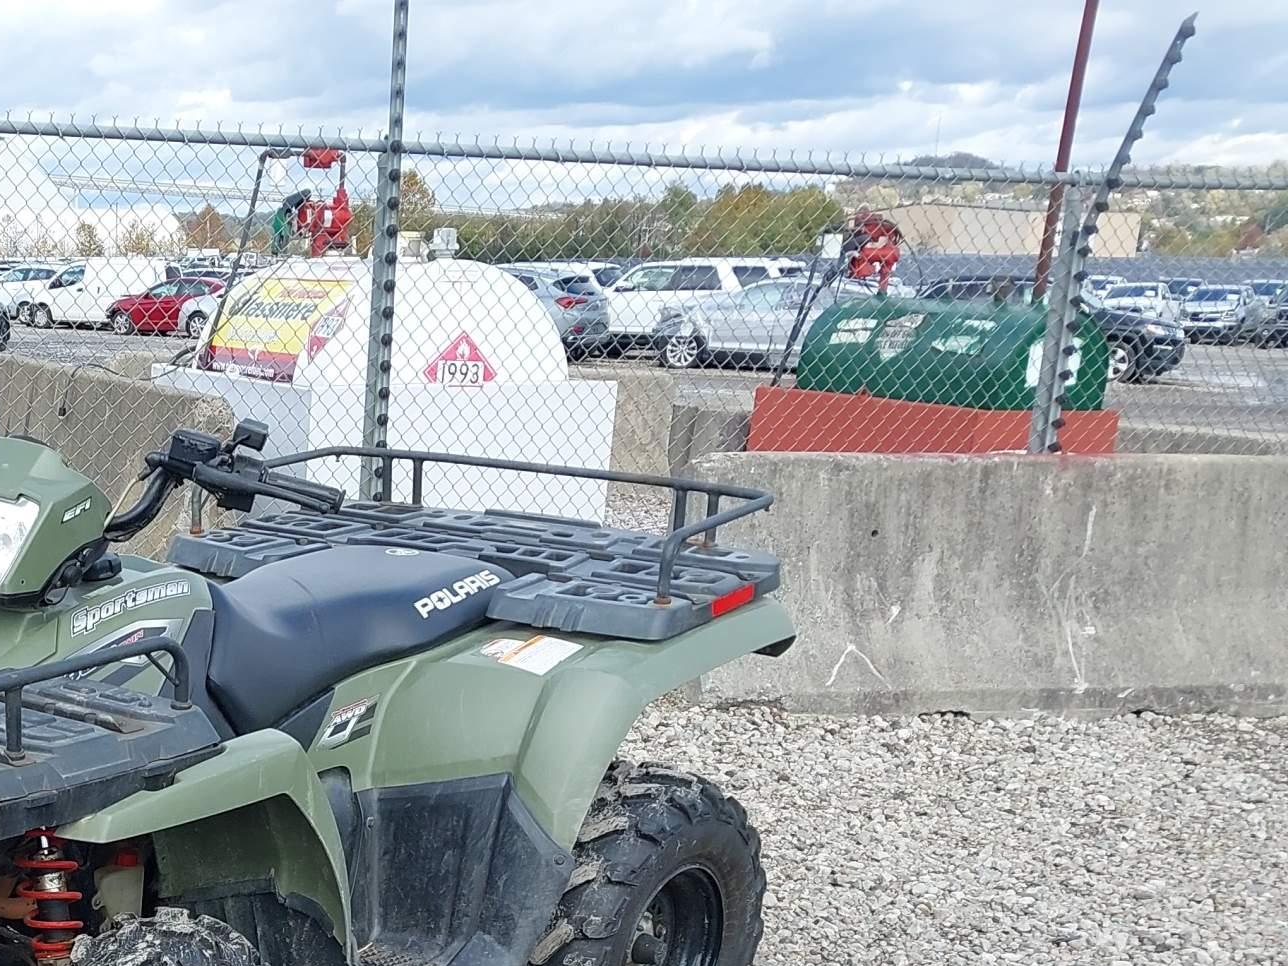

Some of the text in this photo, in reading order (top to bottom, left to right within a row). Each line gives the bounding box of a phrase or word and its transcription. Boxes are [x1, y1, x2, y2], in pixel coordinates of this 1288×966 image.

[440, 363, 480, 384] 1993
[62, 498, 91, 522] EFI
[72, 581, 190, 636] Sportsman
[414, 569, 501, 619] POLARIS
